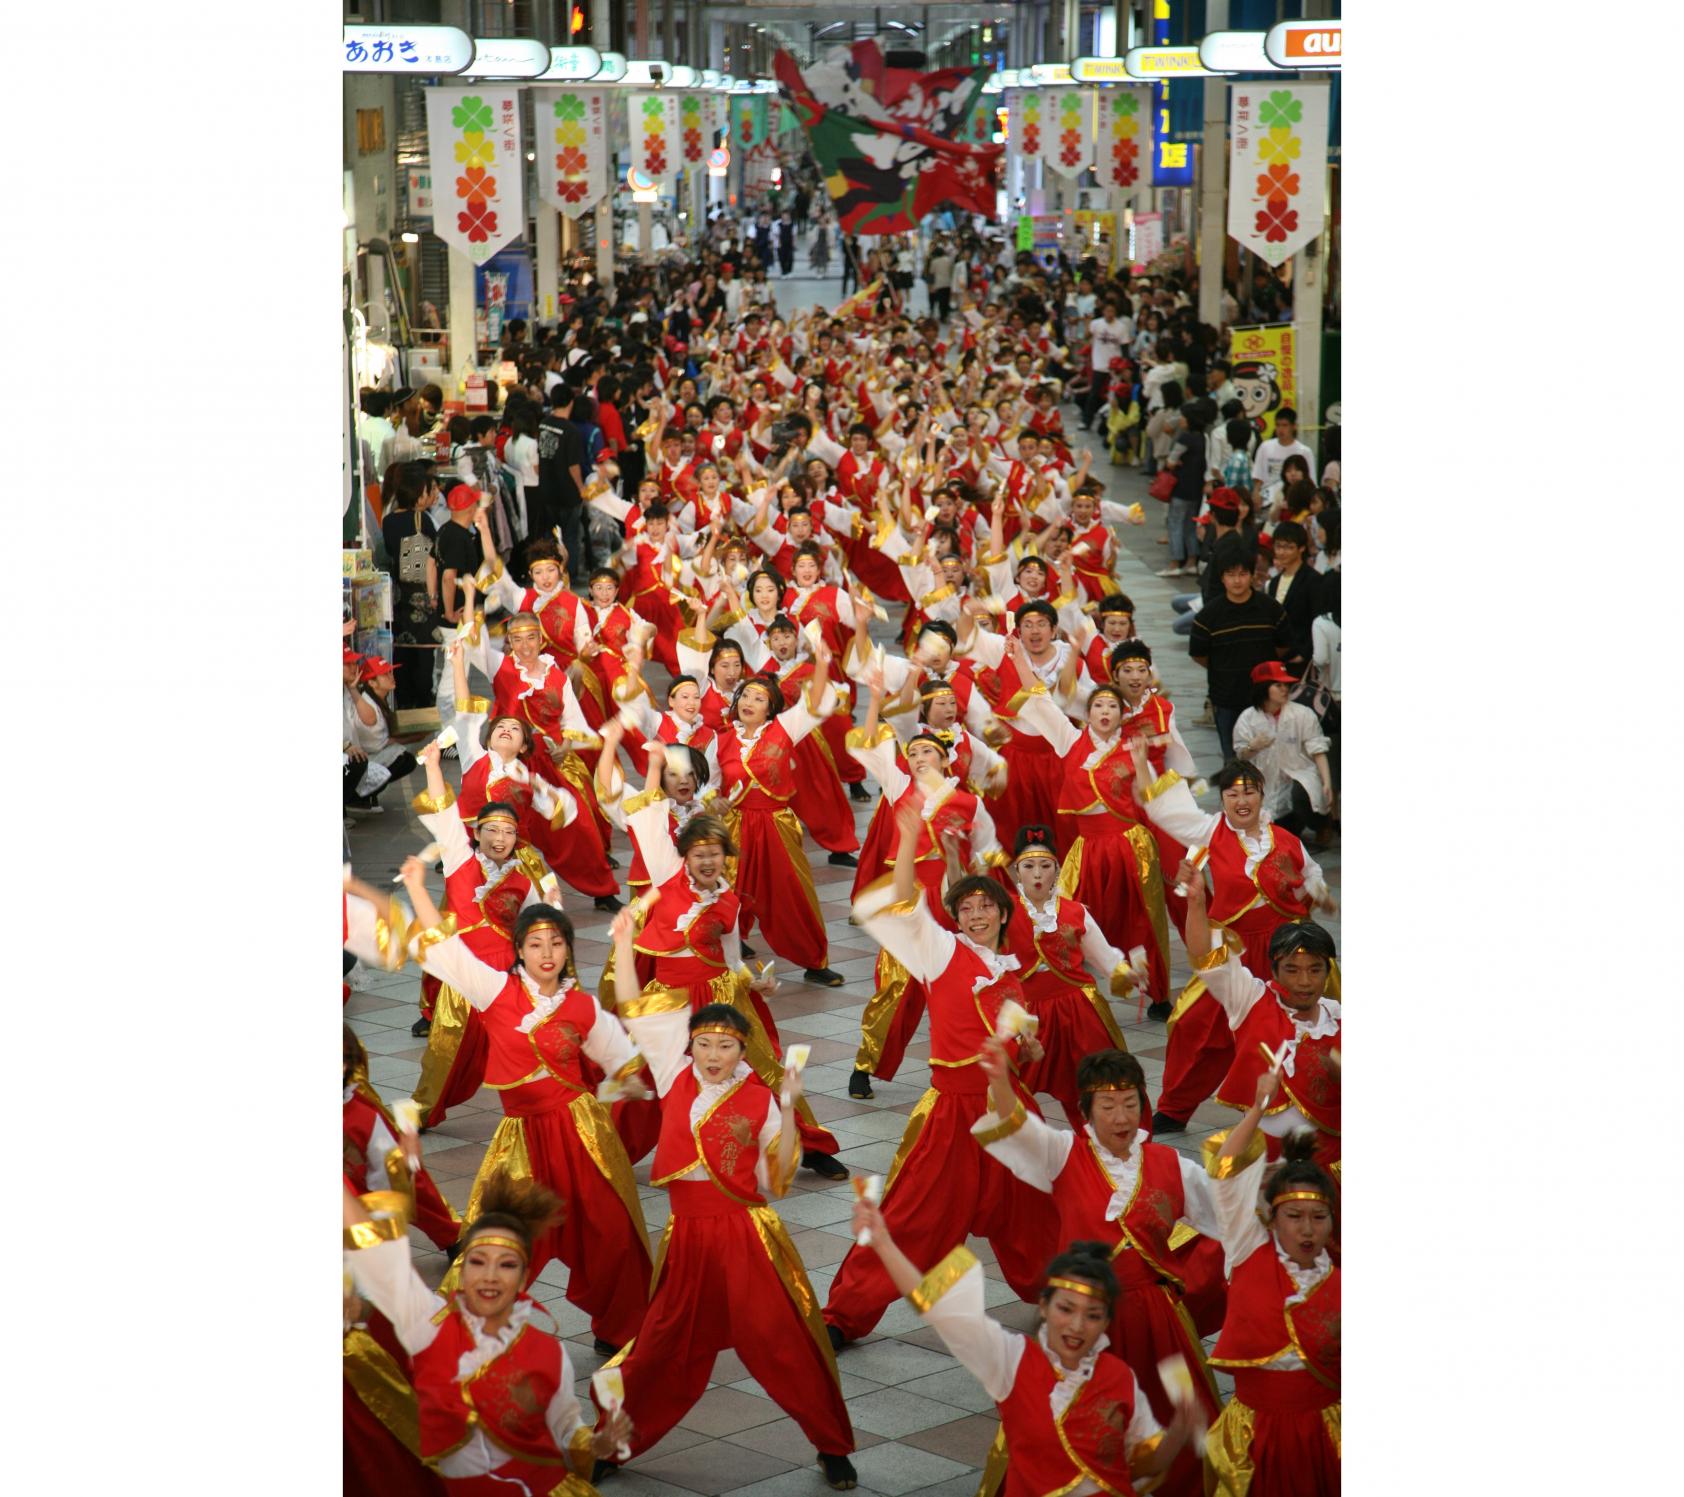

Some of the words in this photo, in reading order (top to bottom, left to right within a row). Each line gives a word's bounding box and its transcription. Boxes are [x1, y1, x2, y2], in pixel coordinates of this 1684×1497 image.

[345, 40, 419, 63] あおき
[1304, 32, 1341, 53] au
